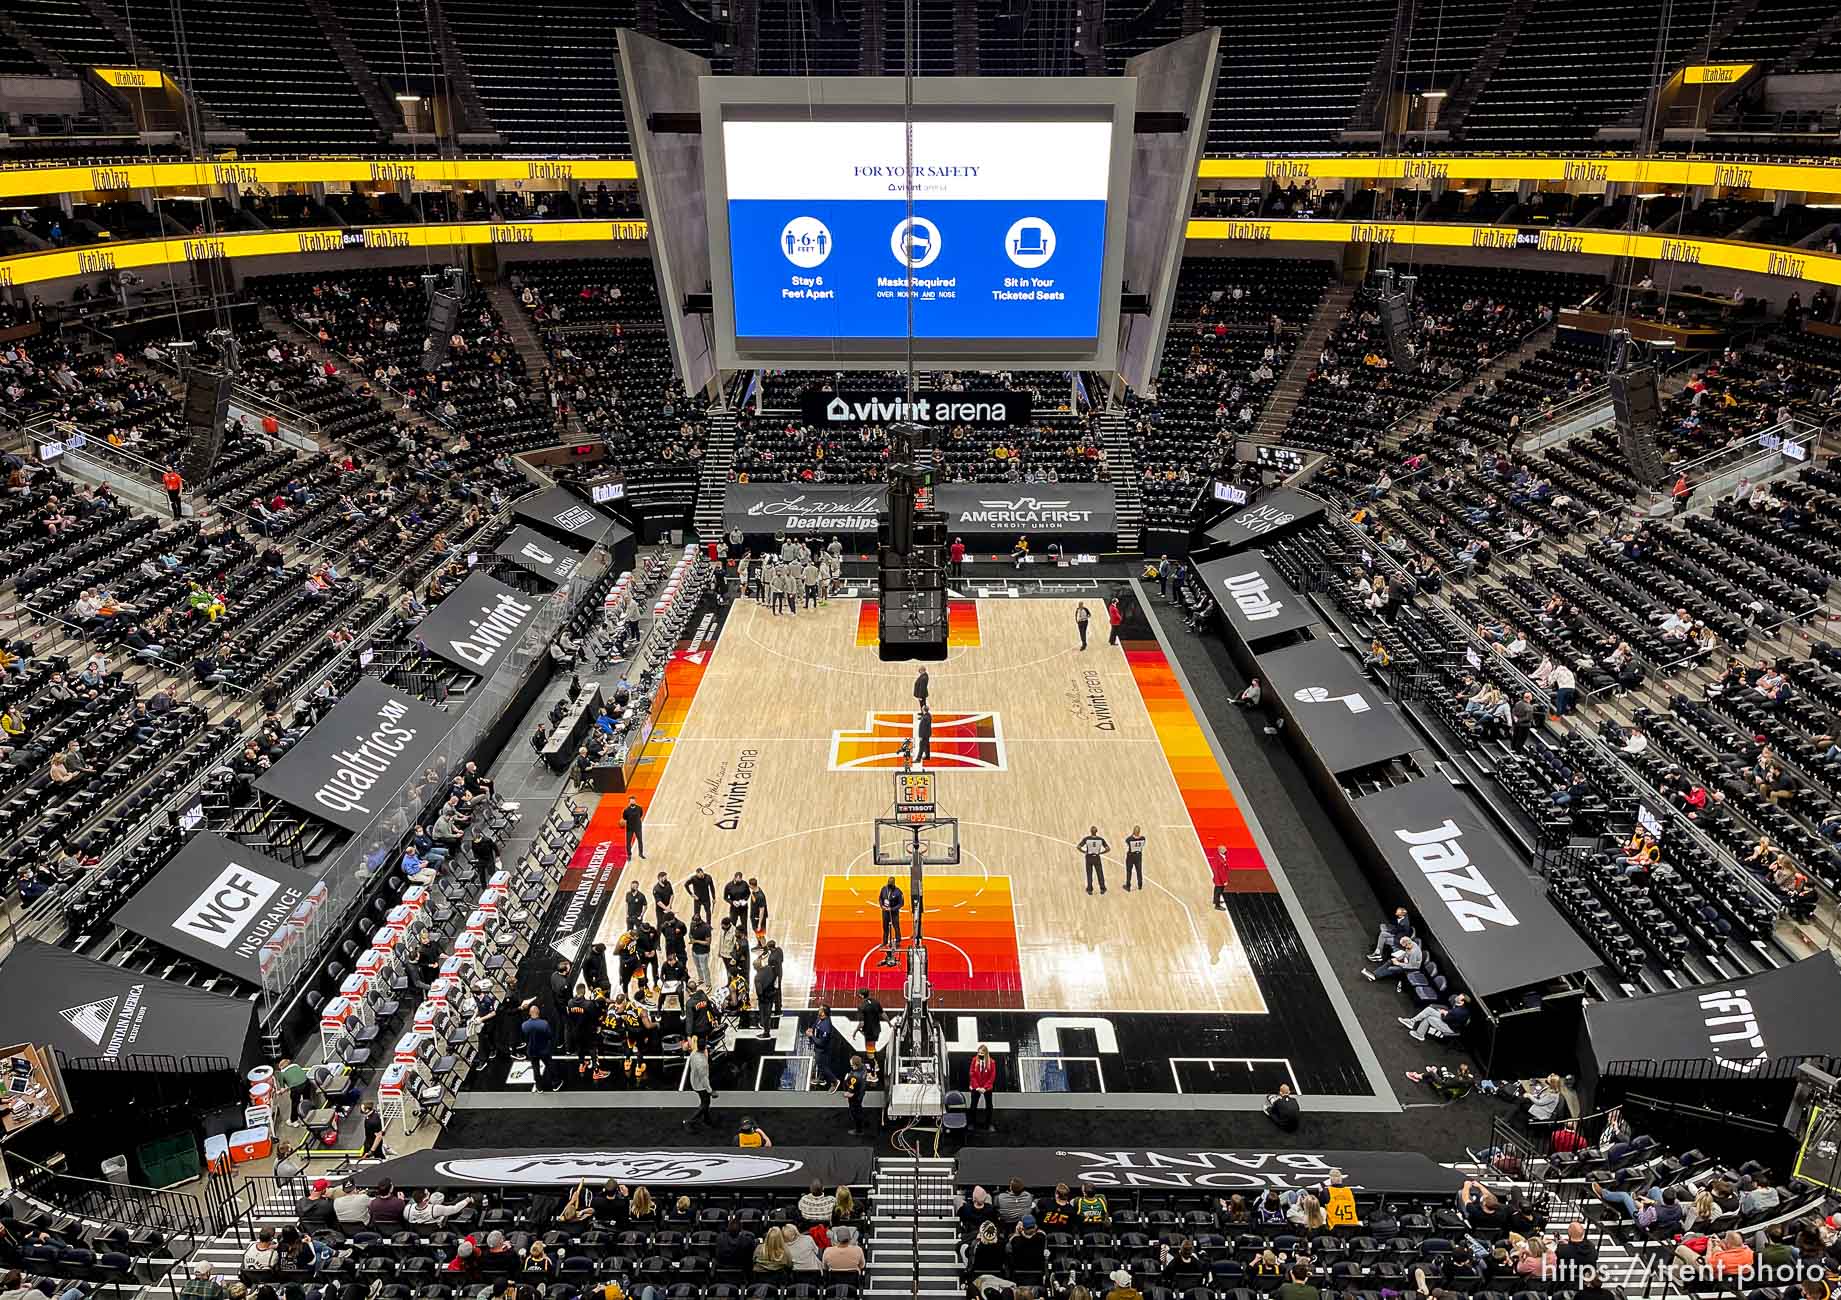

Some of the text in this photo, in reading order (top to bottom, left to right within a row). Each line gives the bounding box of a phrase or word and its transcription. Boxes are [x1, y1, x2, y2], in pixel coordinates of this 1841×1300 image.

[854, 166, 882, 177] FOR
[928, 166, 980, 177] SAFETY
[791, 276, 823, 288] Stay 6
[877, 277, 956, 289] Masks Required
[1004, 277, 1054, 287] Sit in Your
[782, 289, 834, 301] Feet Apart
[992, 290, 1065, 300] Ticketed Seats
[935, 402, 1006, 421] arena
[960, 511, 1093, 522] AMERICA FIRST
[1252, 504, 1284, 521] NU
[786, 516, 880, 530] Dealerships
[1234, 513, 1279, 534] SKIN
[1083, 670, 1104, 694] arena
[735, 749, 758, 779] arena
[556, 840, 613, 932] MOUNTAIN AMERICA
[188, 872, 259, 934] WCF
[235, 887, 303, 959] INSURANCE
[101, 984, 145, 1063] MOUNTAIN AMERICA
[1067, 1151, 1343, 1169] BANK
[1335, 1205, 1353, 1221] 45
